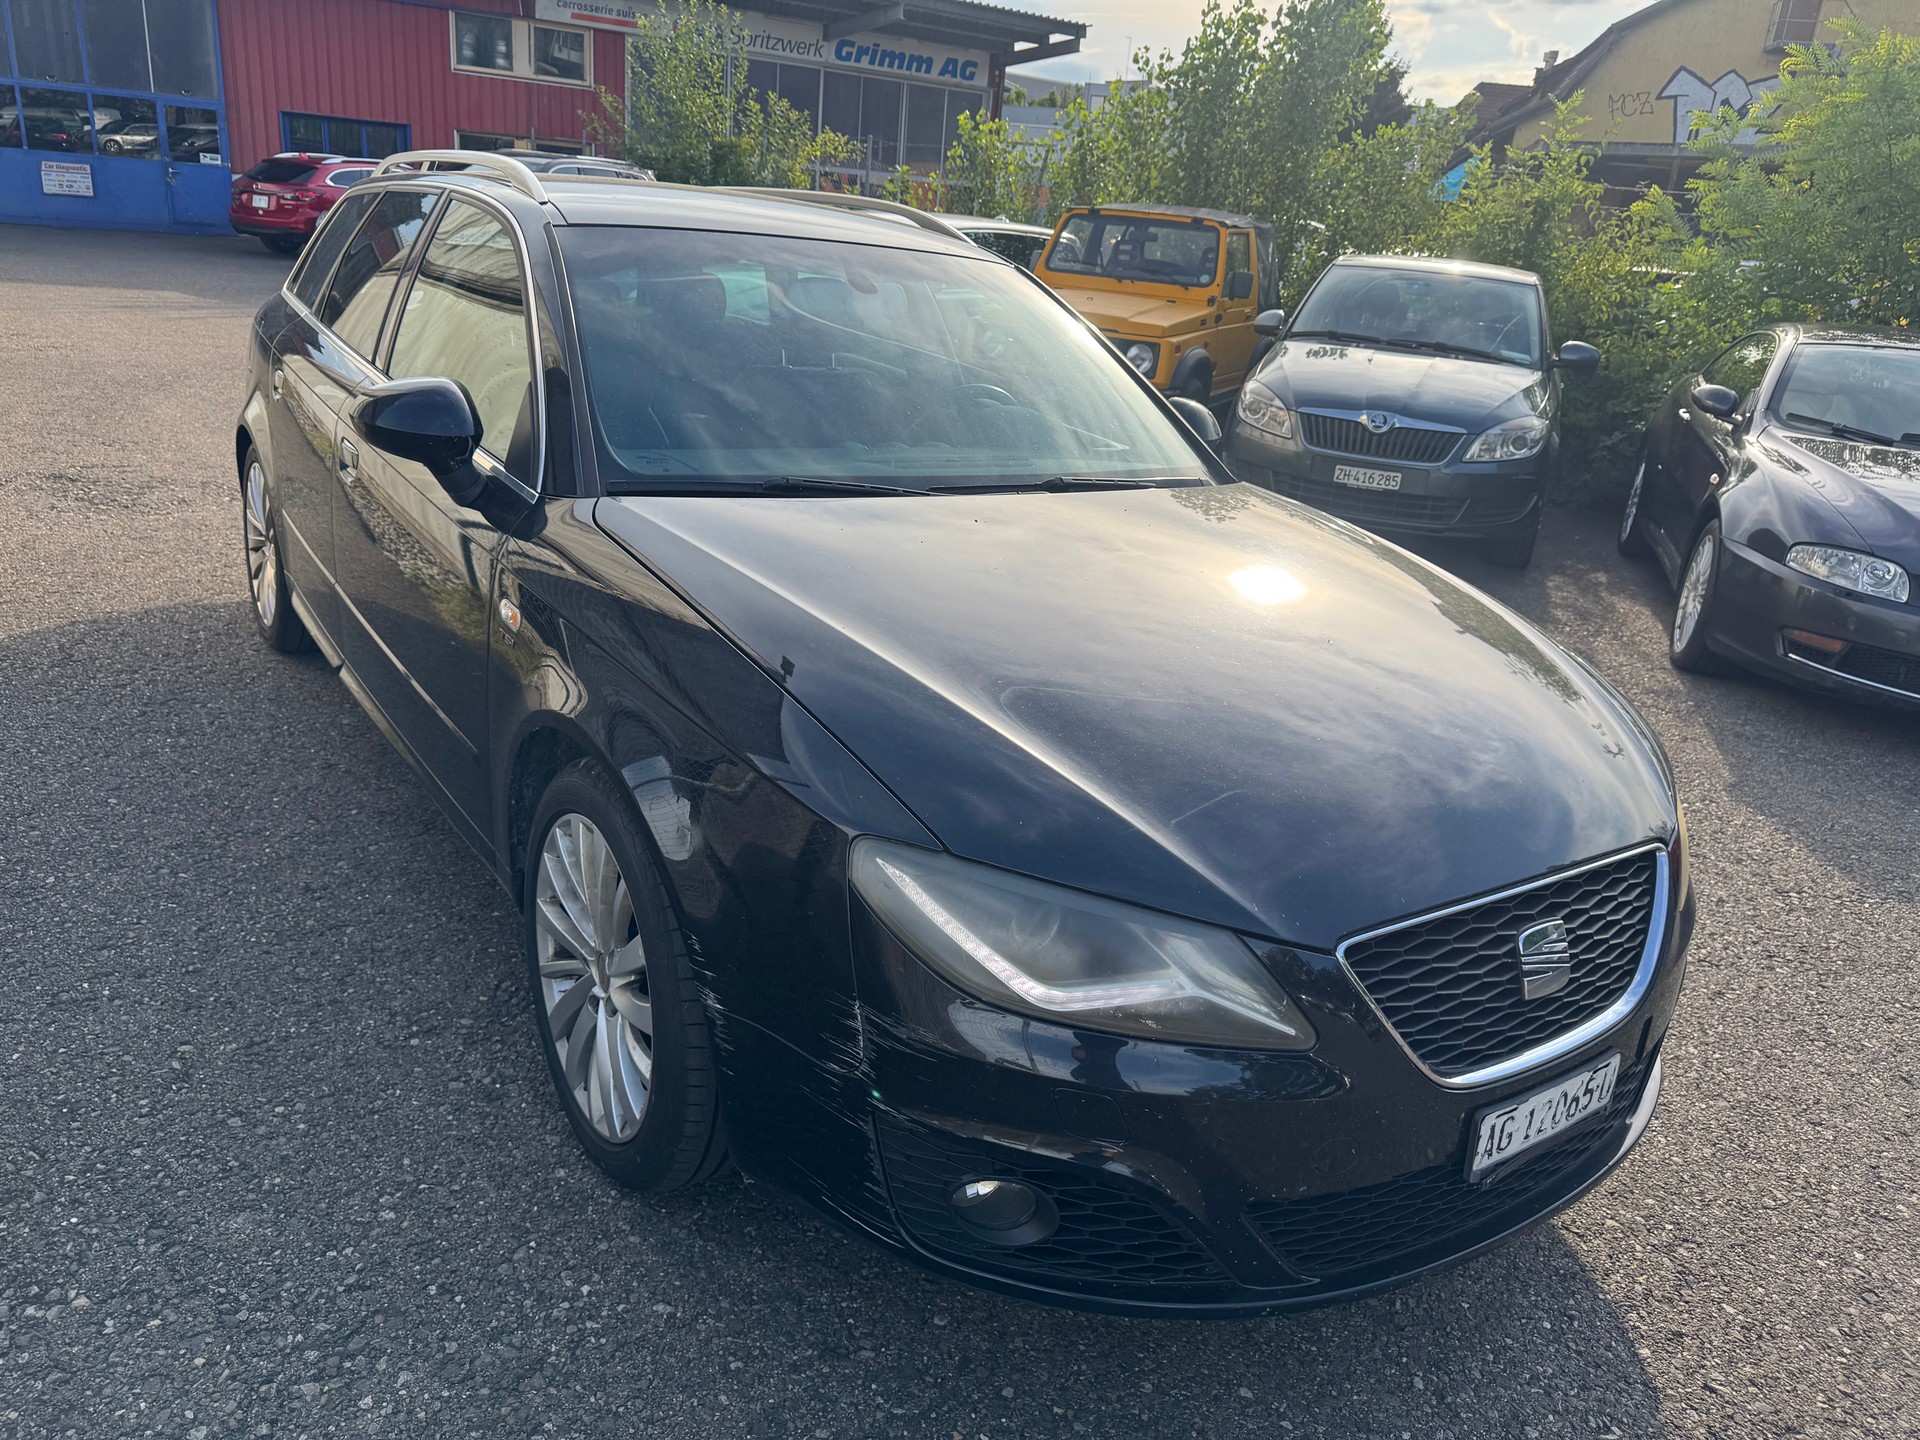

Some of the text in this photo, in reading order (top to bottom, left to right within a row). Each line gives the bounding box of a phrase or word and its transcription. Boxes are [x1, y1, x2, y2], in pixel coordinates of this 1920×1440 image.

[556, 0, 614, 16] carrosserie
[834, 38, 979, 81] Grimm AG
[55, 164, 88, 172] Diagnostic
